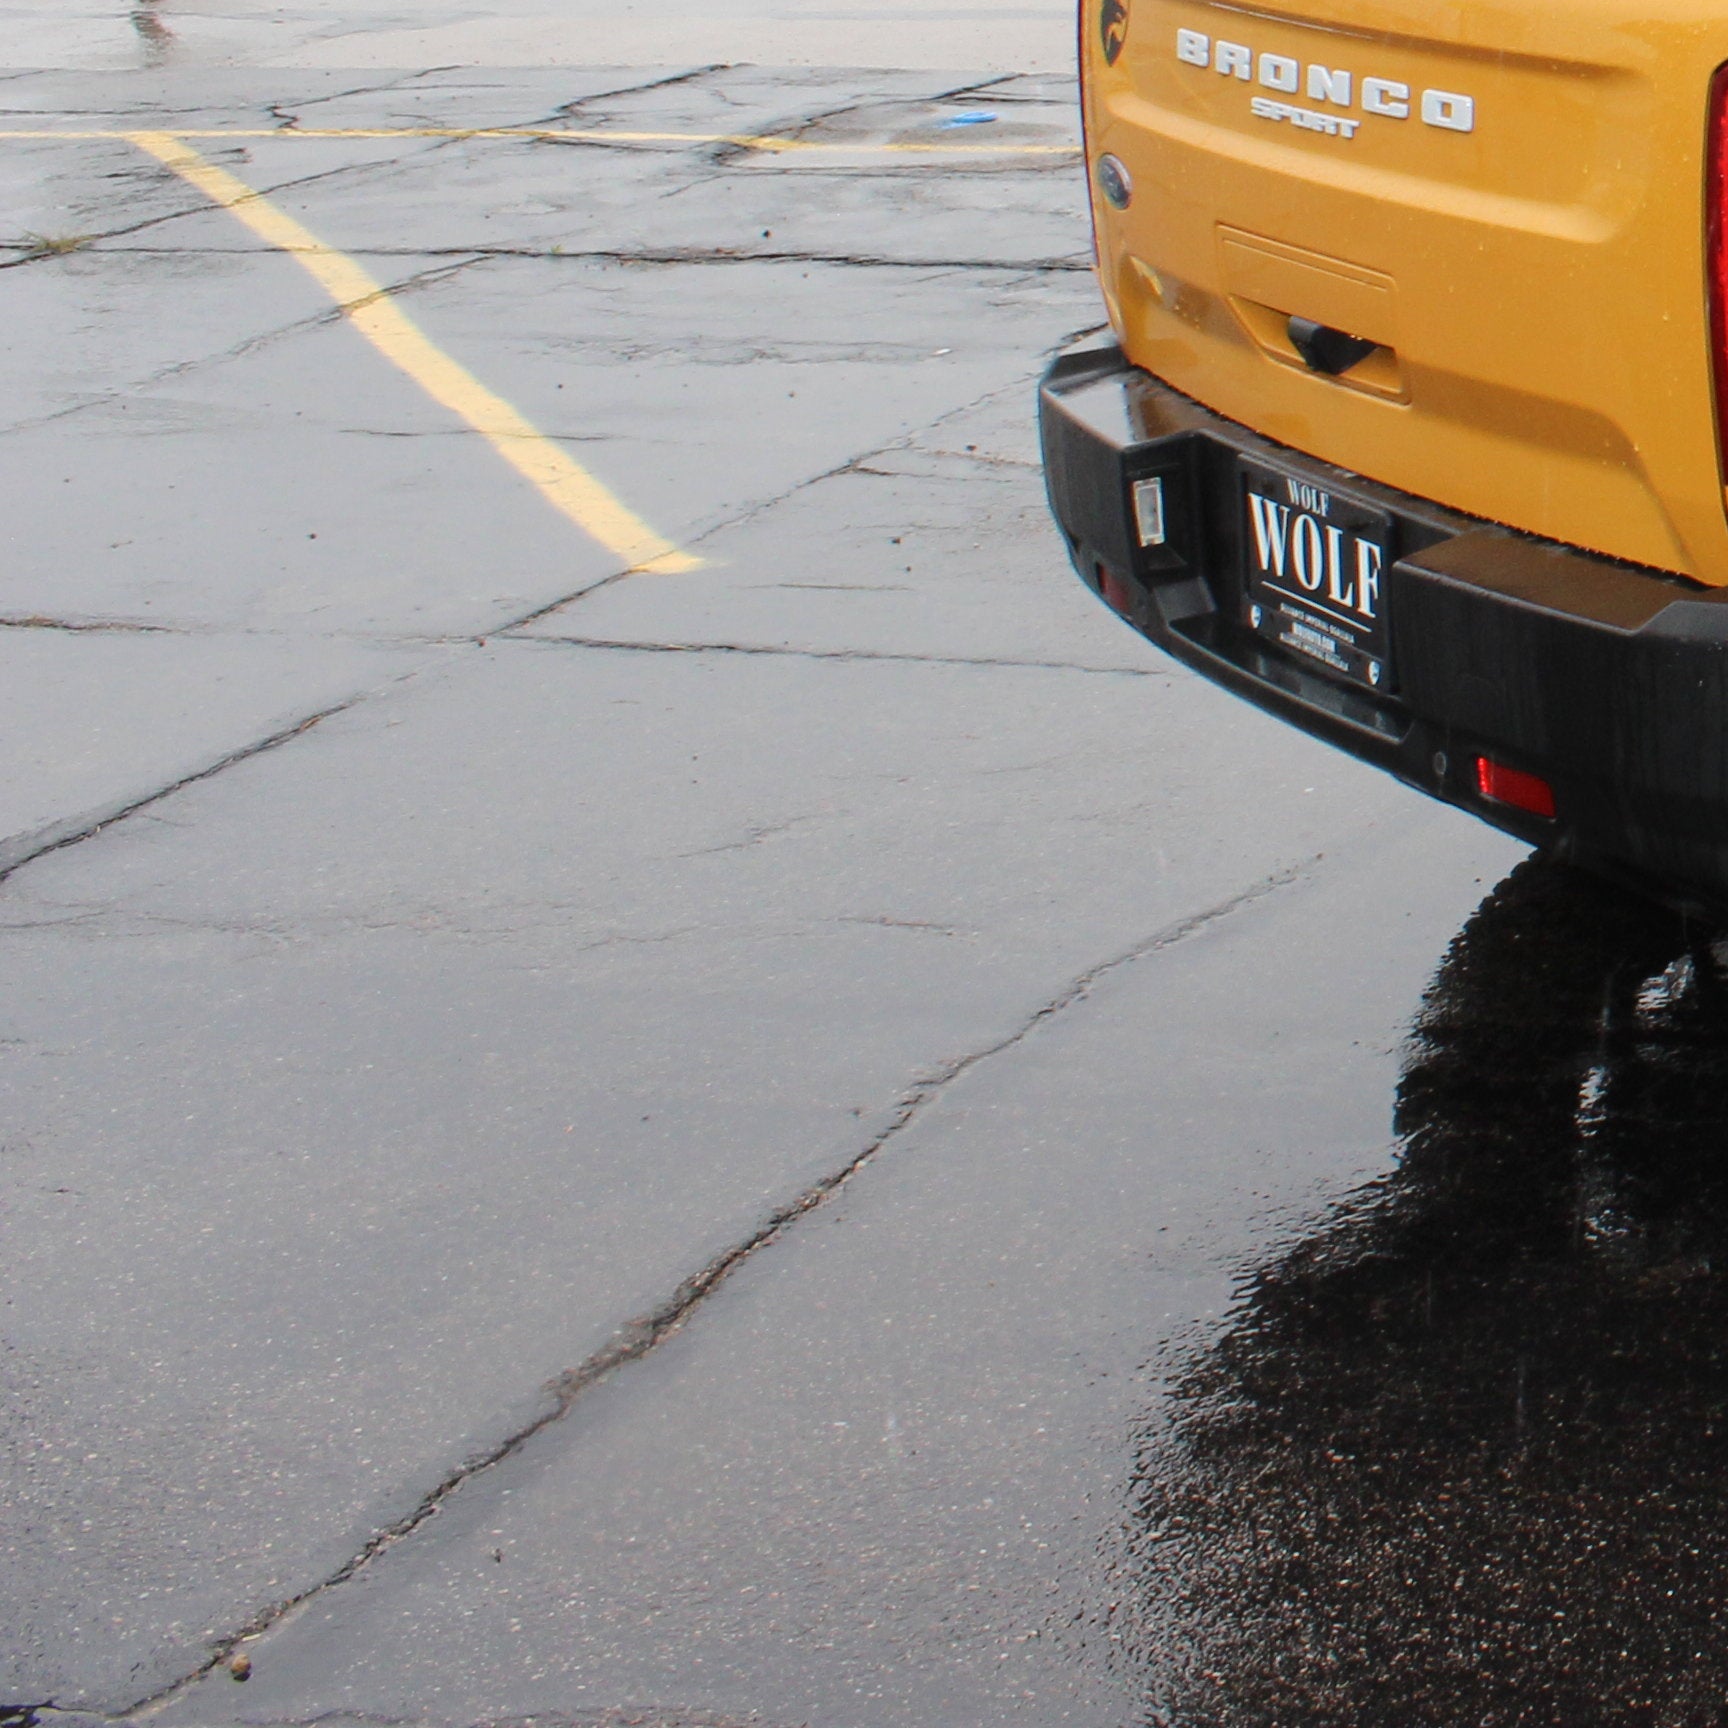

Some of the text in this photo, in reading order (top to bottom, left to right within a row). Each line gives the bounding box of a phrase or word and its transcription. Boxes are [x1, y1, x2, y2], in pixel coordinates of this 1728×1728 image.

[1176, 27, 1474, 133] BRONCO
[1250, 96, 1361, 139] SPORT
[1286, 477, 1330, 518] WOLF
[1248, 492, 1382, 619] WOLF
